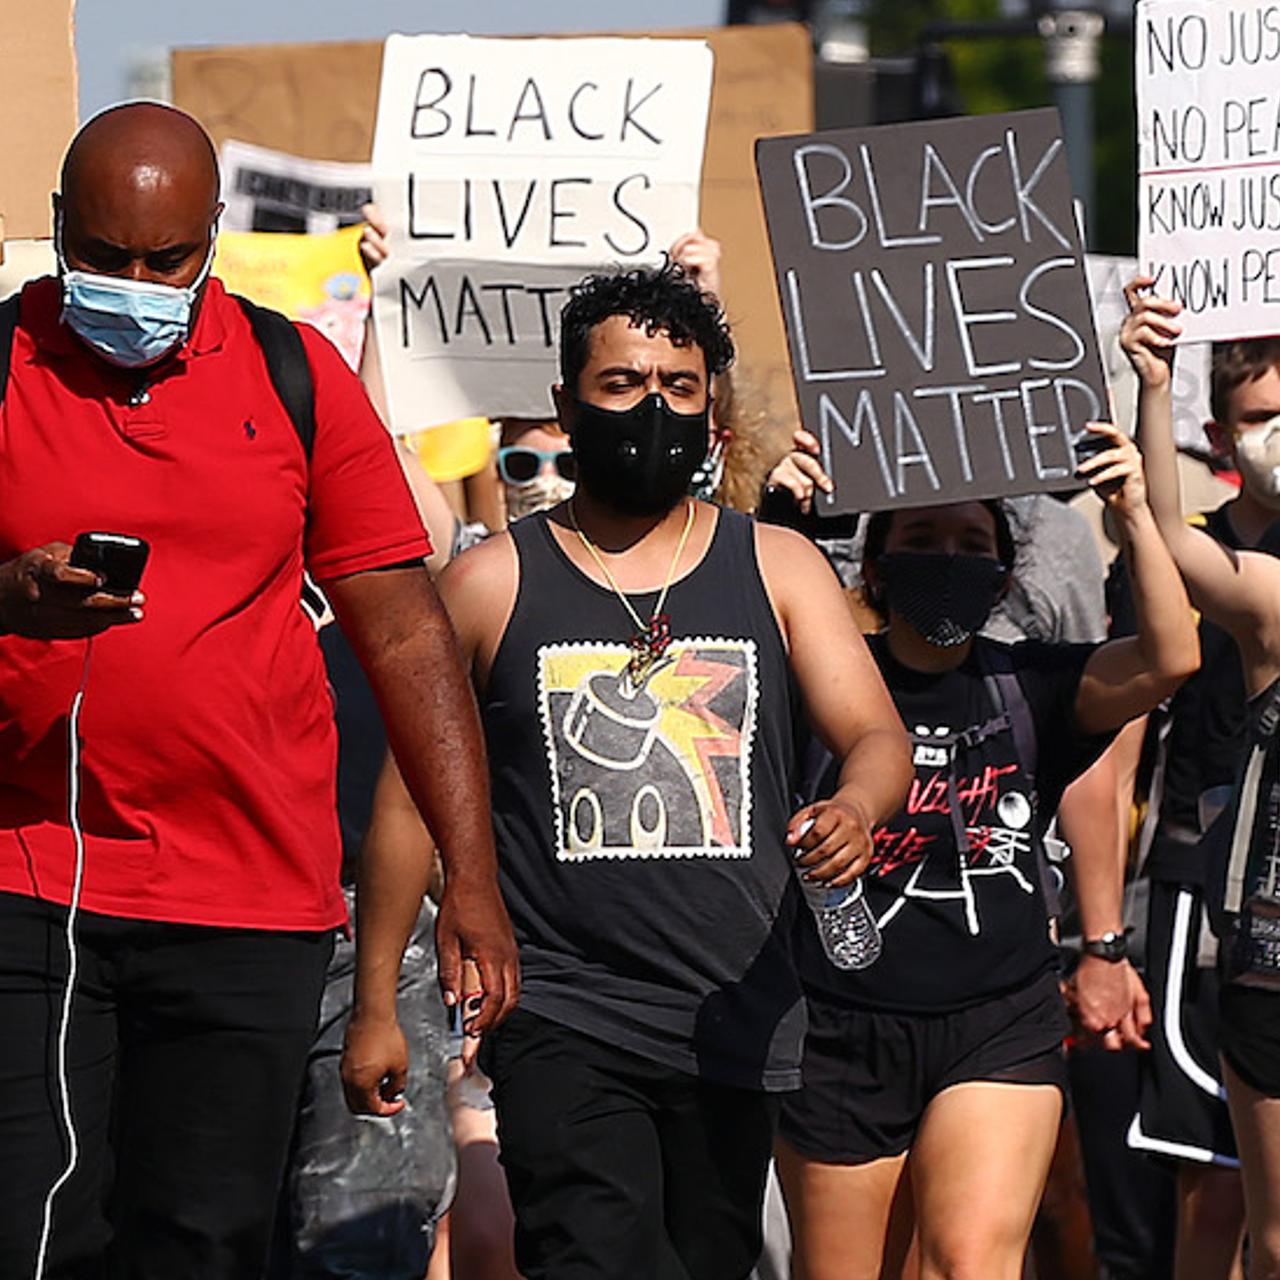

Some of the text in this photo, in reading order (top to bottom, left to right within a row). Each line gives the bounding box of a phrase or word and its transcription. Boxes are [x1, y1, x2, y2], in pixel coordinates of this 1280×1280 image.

[1147, 15, 1207, 75] NO
[409, 67, 664, 144] BLACK
[1153, 106, 1207, 167] NO
[406, 172, 653, 256] LIVES
[793, 129, 1074, 251] BLACK
[1148, 179, 1225, 234] KNOW
[398, 273, 565, 348] MATT
[787, 257, 1085, 380] LIVES
[1149, 259, 1228, 314] KNOW
[819, 377, 1101, 505] MATTER
